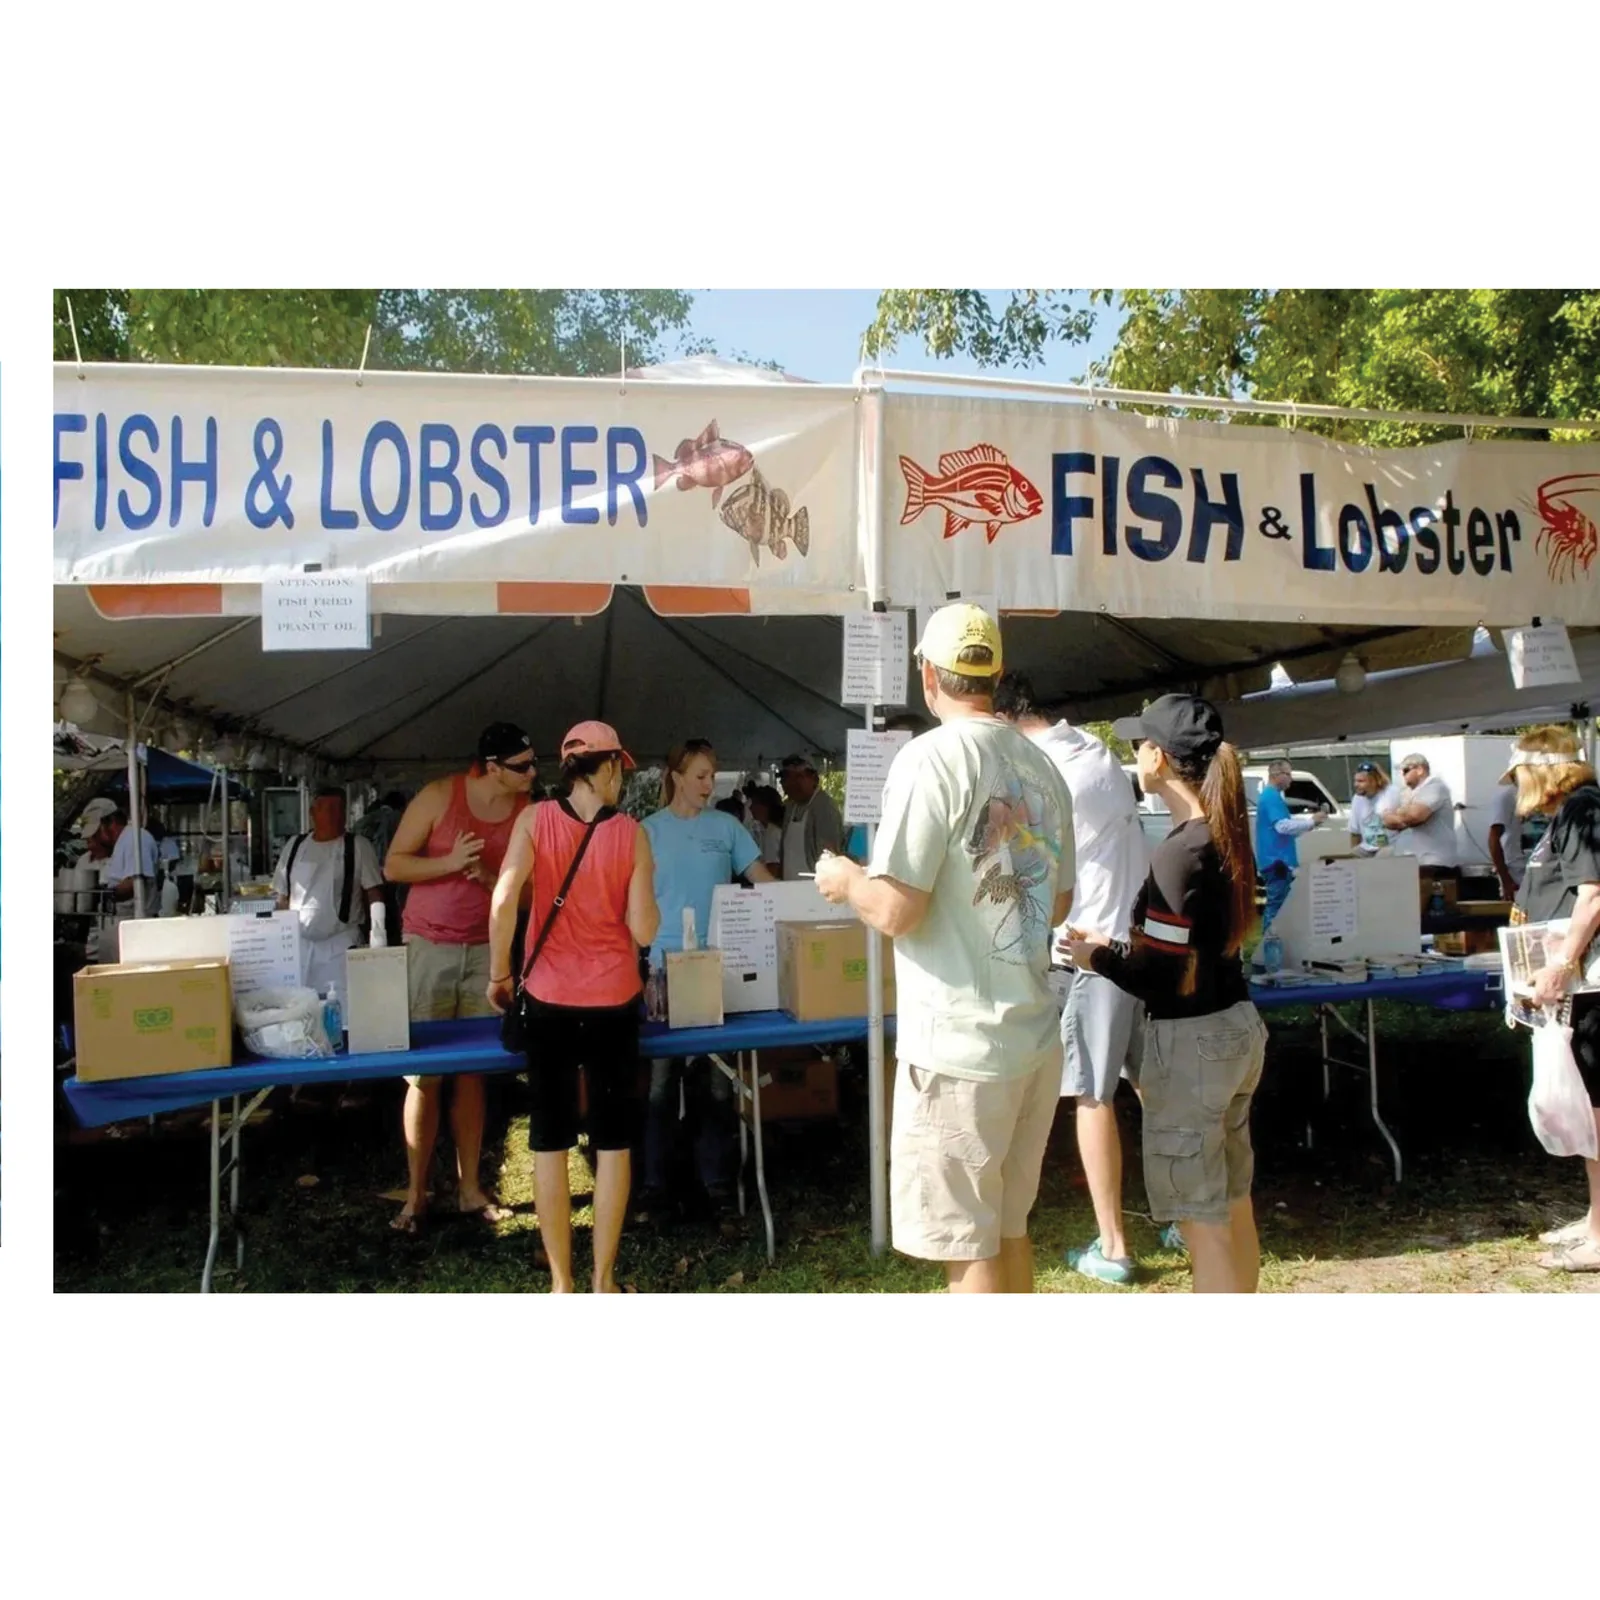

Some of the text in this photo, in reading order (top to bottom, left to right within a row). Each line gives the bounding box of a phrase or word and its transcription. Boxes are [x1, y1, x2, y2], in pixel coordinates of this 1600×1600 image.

[53, 413, 648, 532] FISH & LOBSTER
[1051, 452, 1522, 577] FISH & Lobster
[278, 597, 353, 606] FISH FRIED
[309, 610, 323, 618] IN
[278, 623, 329, 632] PEANUT
